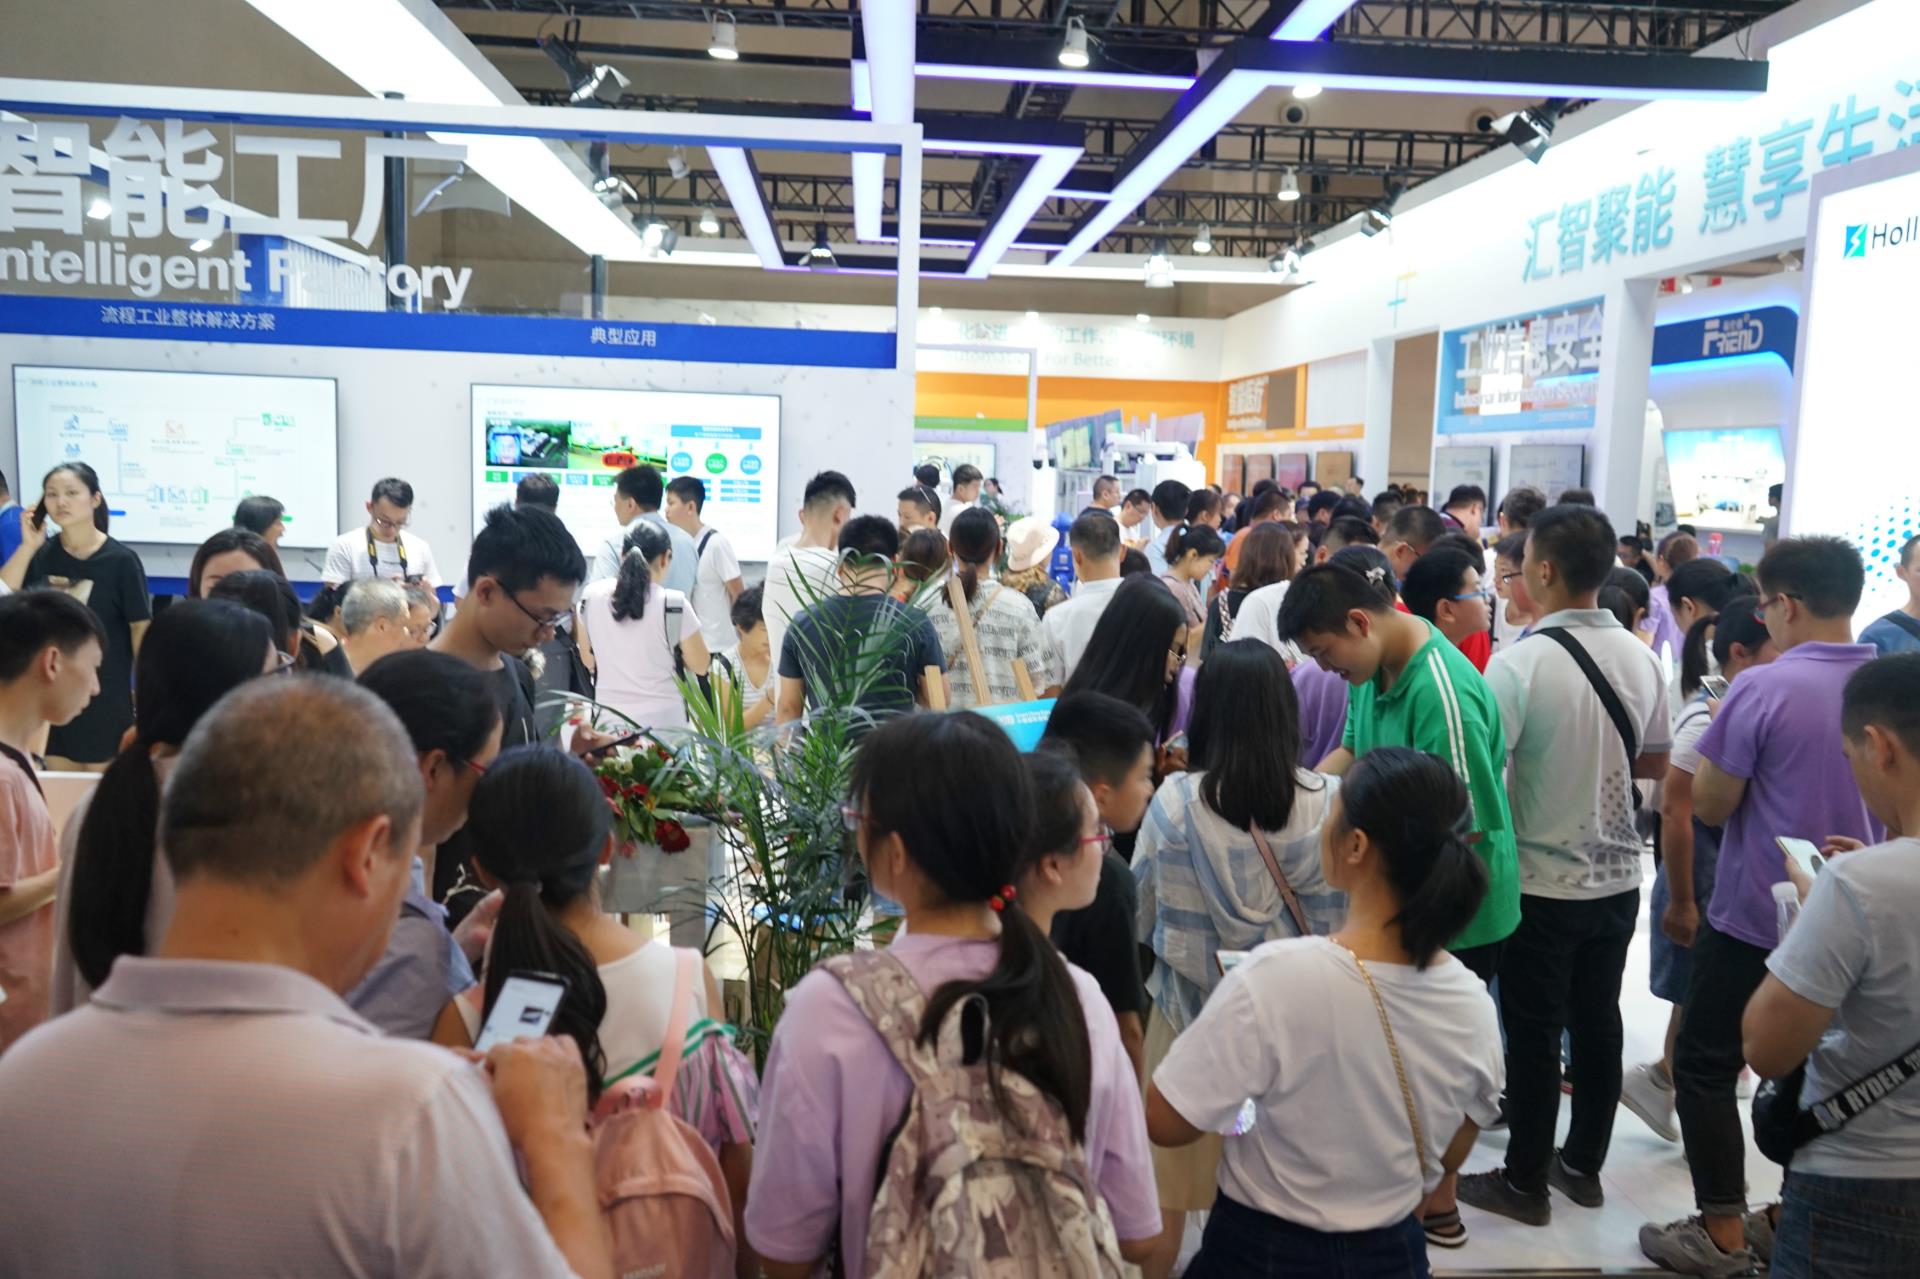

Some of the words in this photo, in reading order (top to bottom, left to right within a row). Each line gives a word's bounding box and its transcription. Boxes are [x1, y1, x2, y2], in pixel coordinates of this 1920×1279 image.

[0, 115, 467, 248] 智能工厂
[1522, 165, 1677, 282] 汇智聚能
[1698, 79, 1920, 235] 慧享生
[1872, 216, 1918, 249] Holl
[101, 305, 276, 331] 流程工业整体解决方案
[590, 326, 657, 348] 典型应用
[1456, 304, 1604, 378] 工业信息安全
[1844, 1064, 1905, 1113] RYDEN
